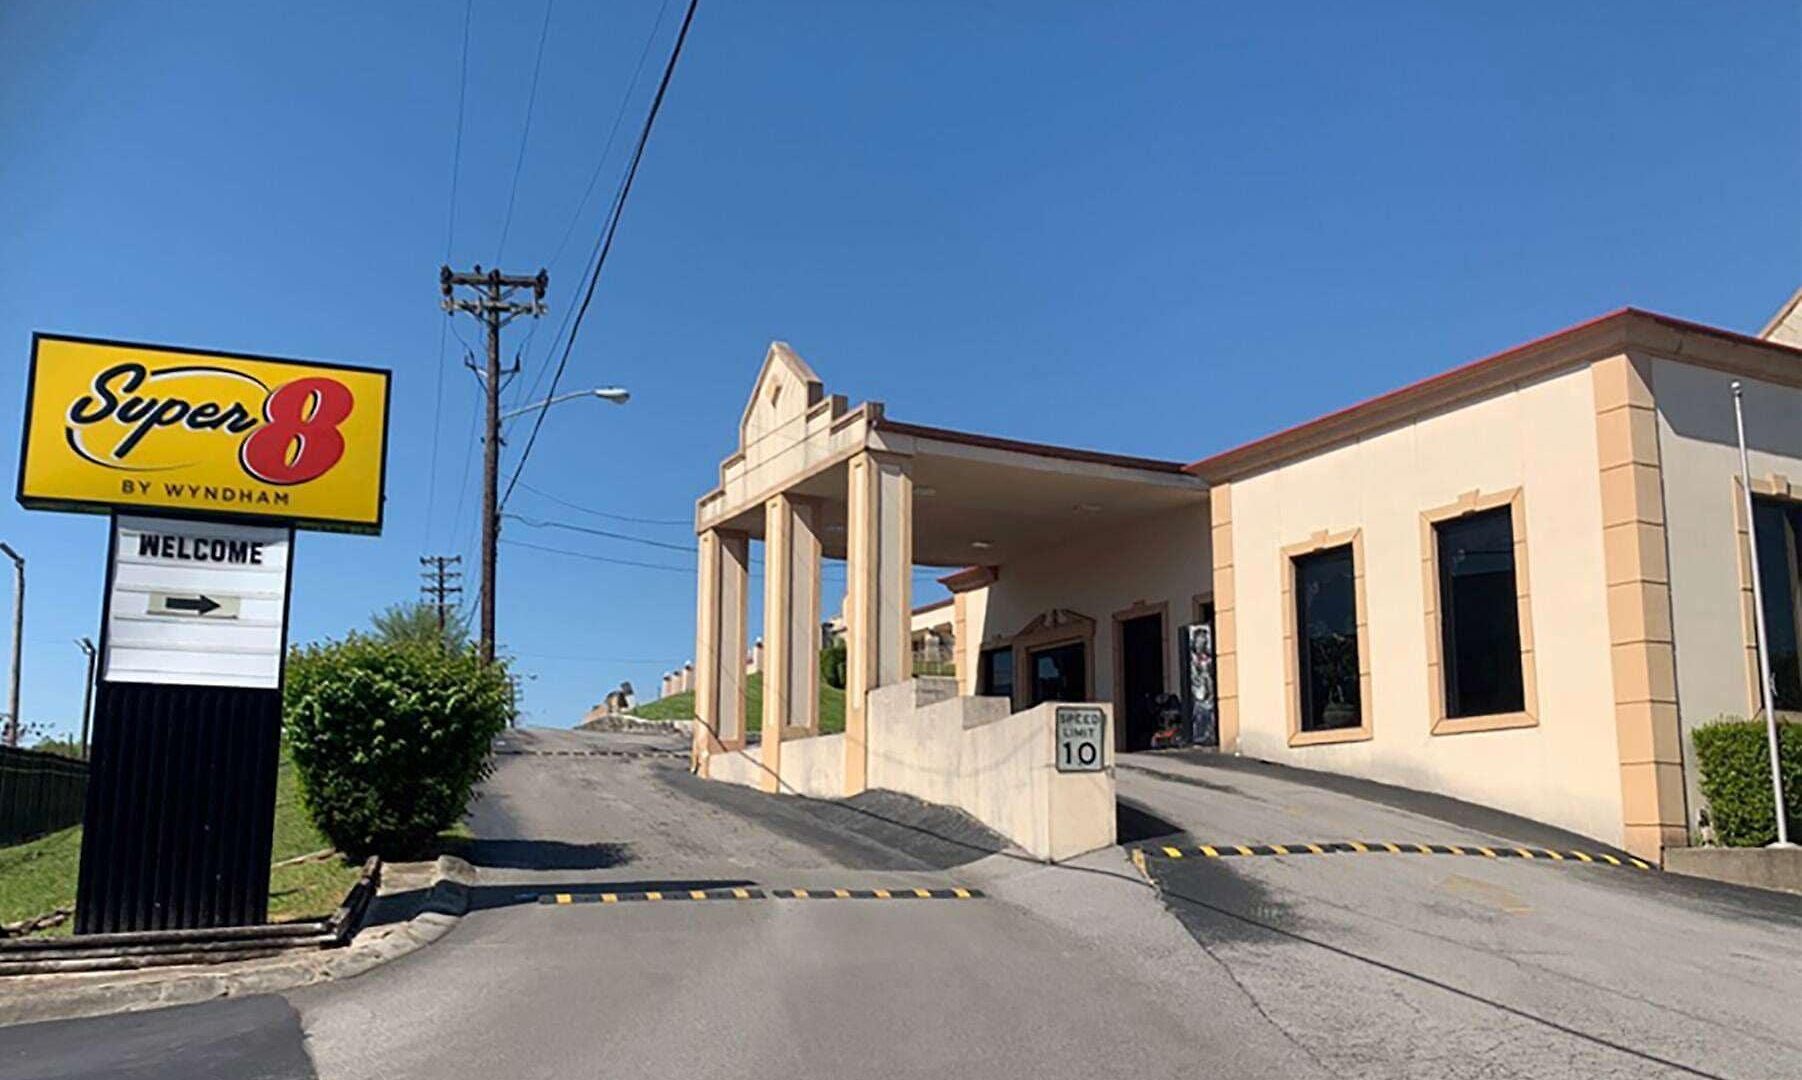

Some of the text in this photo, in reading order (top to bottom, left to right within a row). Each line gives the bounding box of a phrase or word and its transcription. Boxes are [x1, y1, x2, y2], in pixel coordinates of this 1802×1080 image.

[70, 363, 354, 485] Super 8
[121, 480, 290, 505] BY WYNDHAM
[138, 534, 263, 565] WELCOME
[1063, 742, 1096, 765] 10
